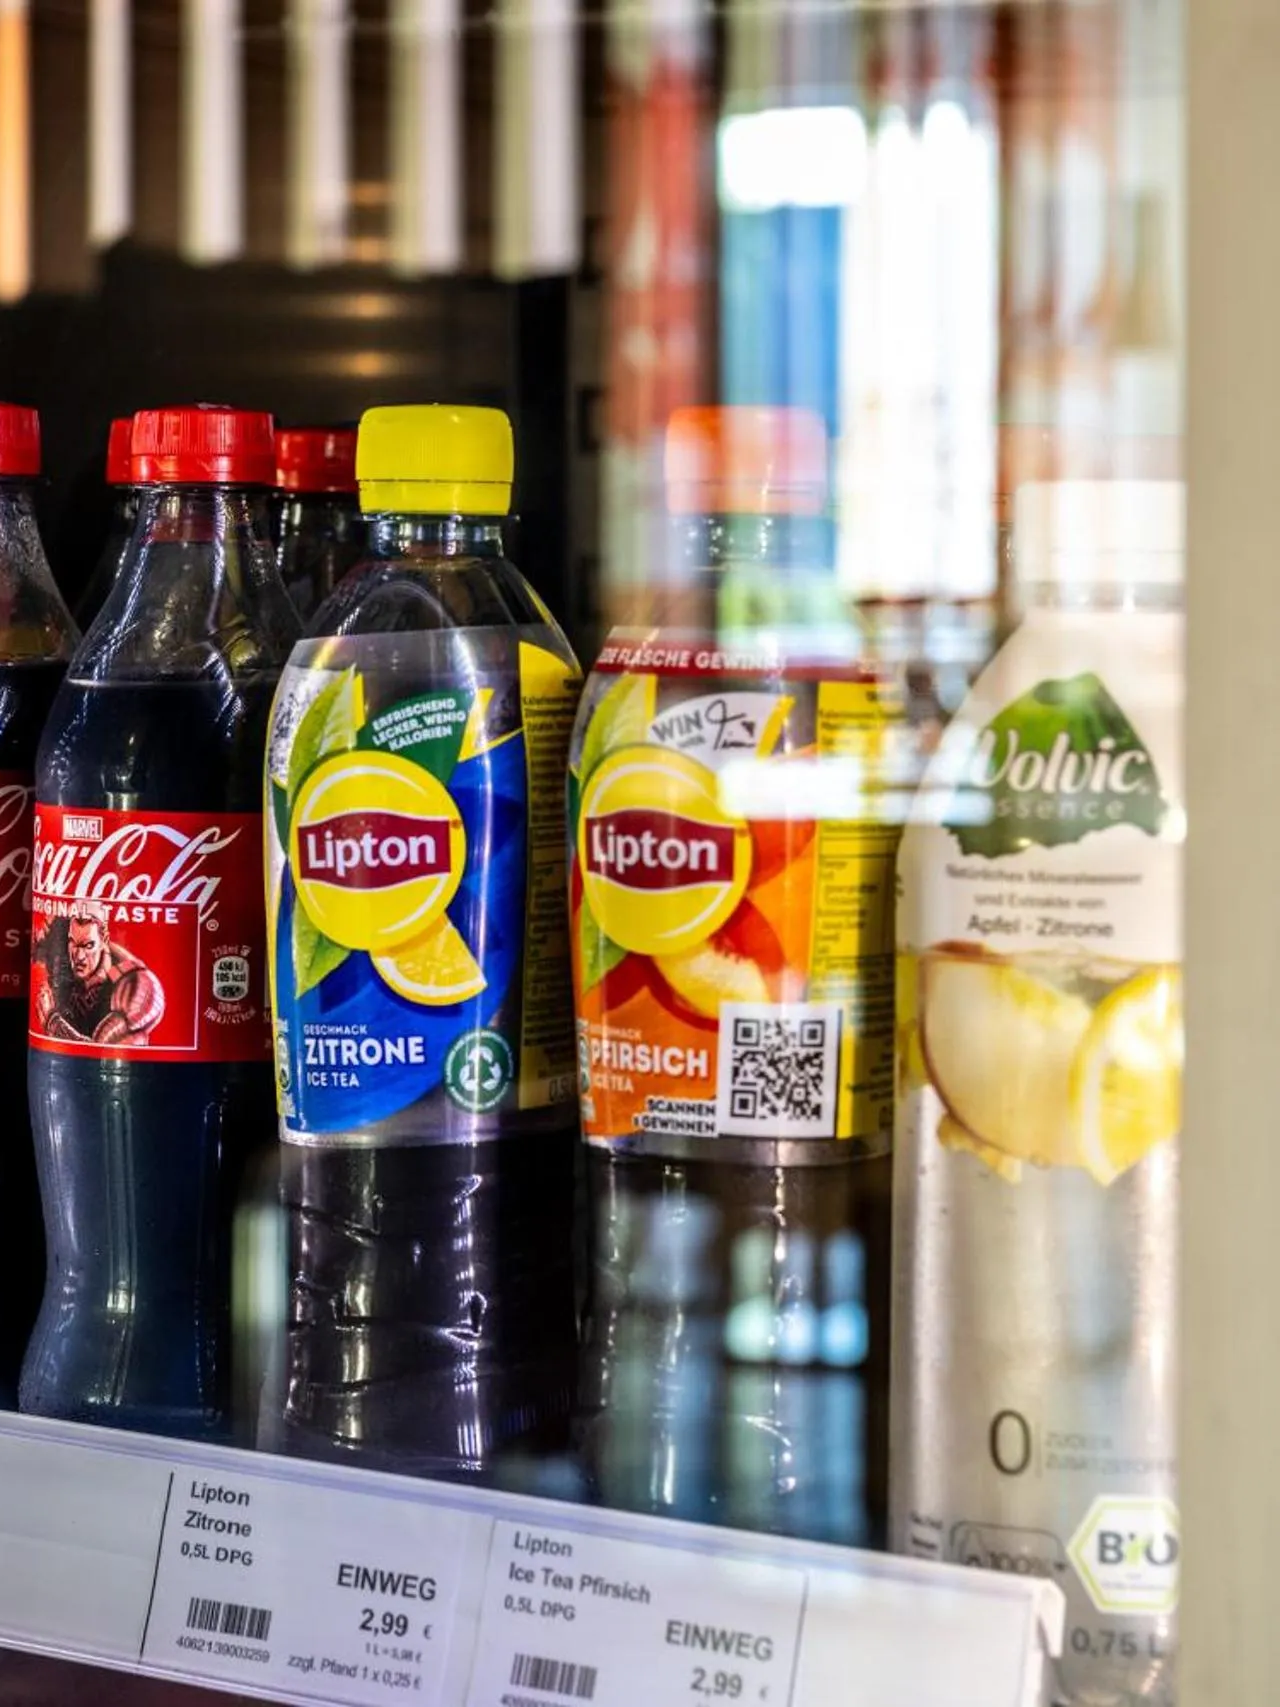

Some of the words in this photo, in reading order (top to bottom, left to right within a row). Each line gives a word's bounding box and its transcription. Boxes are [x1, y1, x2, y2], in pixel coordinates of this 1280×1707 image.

[619, 648, 689, 668] FLASCHE
[373, 698, 456, 731] ERFRISCHEND
[424, 711, 466, 726] WENIG
[652, 709, 703, 742] WIN
[390, 726, 453, 751] KALORIEN
[973, 729, 1146, 794] Volvic
[996, 798, 1126, 820] ssence
[63, 816, 103, 842] MARVEL
[307, 830, 436, 877] Lipton
[591, 824, 719, 873] Lipton
[103, 903, 180, 925] TASTE
[968, 914, 1019, 935] Apfel
[1036, 918, 1114, 938] Zitrone
[304, 1024, 367, 1036] GESCHMACK
[305, 1036, 425, 1066] ZITRONE
[590, 1038, 708, 1079] PFIRSICH
[307, 1071, 328, 1087] ICE
[332, 1072, 360, 1088] TEA
[648, 1098, 716, 1116] SCANNEN
[642, 1115, 716, 1133] GEWINNEN
[989, 1409, 1031, 1476] 0
[190, 1481, 250, 1506] Lipton
[184, 1510, 252, 1537] Zitrone
[180, 1541, 210, 1560] 0,5L
[215, 1546, 254, 1566] DPG
[514, 1531, 573, 1557] Lipton
[337, 1563, 437, 1601] EINWEG
[509, 1562, 535, 1584] Ice
[541, 1567, 574, 1591] Tea
[579, 1573, 651, 1604] Pfirsich
[504, 1595, 536, 1614] 0,5L
[540, 1603, 576, 1621] DPG
[359, 1608, 409, 1638] 2,99
[665, 1620, 774, 1663] EINWEG
[1071, 1627, 1138, 1658] 0,75
[1149, 1635, 1164, 1656] L
[287, 1655, 316, 1674] zzgl.
[320, 1657, 359, 1678] Pfand
[382, 1669, 412, 1688] 0,25
[691, 1668, 743, 1699] 2,99
